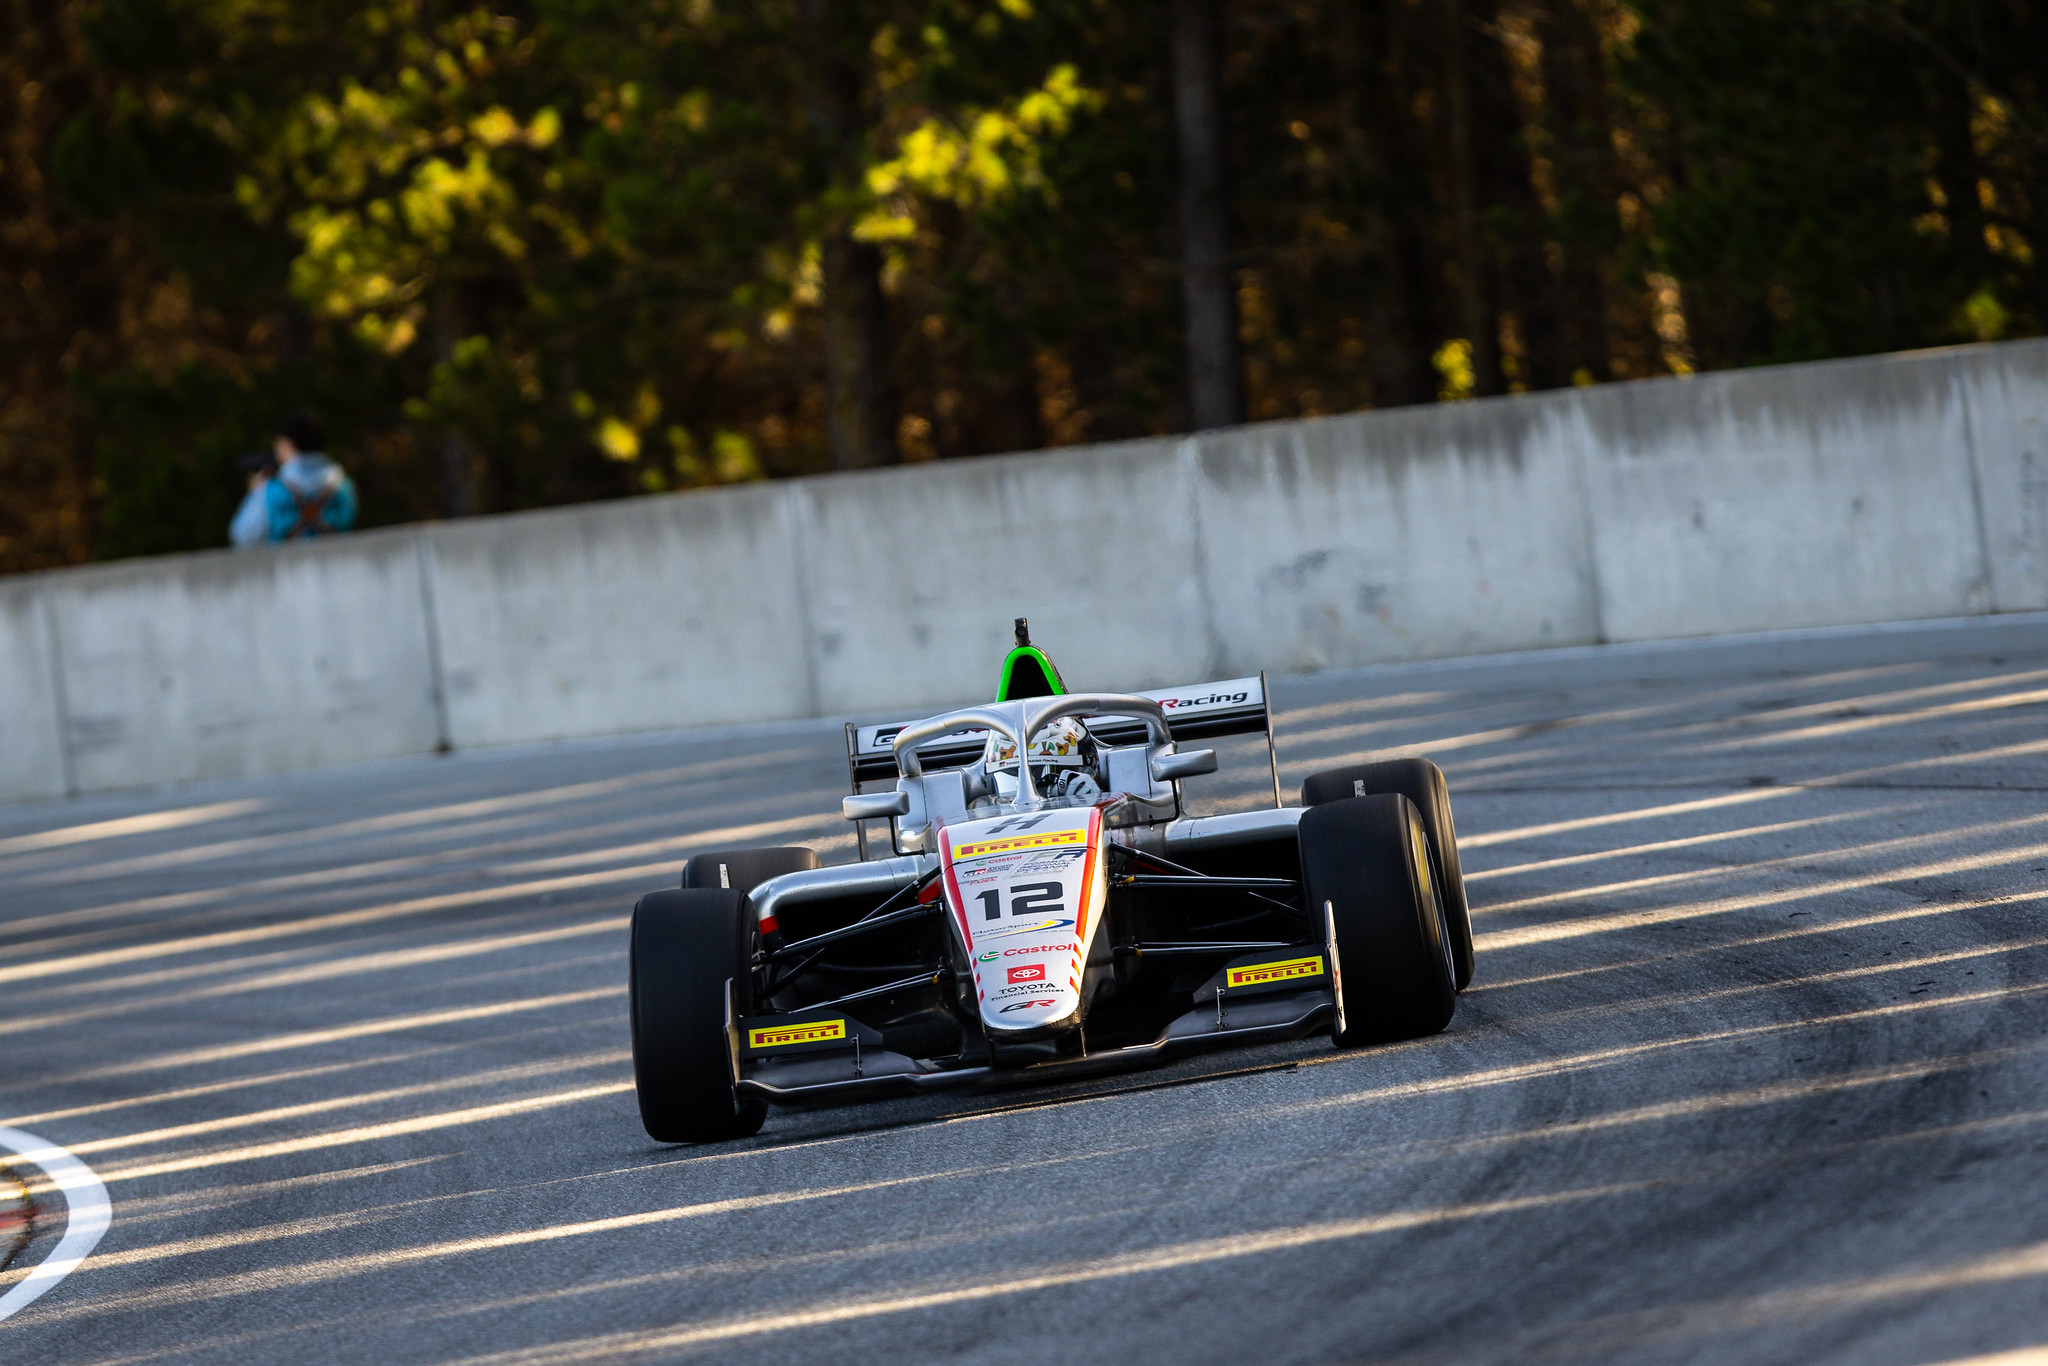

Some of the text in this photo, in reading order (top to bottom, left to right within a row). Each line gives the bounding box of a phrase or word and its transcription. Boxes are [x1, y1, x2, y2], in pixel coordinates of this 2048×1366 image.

[1158, 691, 1248, 709] Racing
[961, 832, 1077, 856] PIRELLI
[988, 855, 1022, 864] Castrol
[975, 881, 1065, 920] 12
[1004, 943, 1072, 957] Castrol
[1233, 961, 1317, 983] PIRELLI
[991, 990, 1029, 1001] Financial
[999, 983, 1056, 994] TOYOTA
[755, 1024, 839, 1044] PIRELLI
